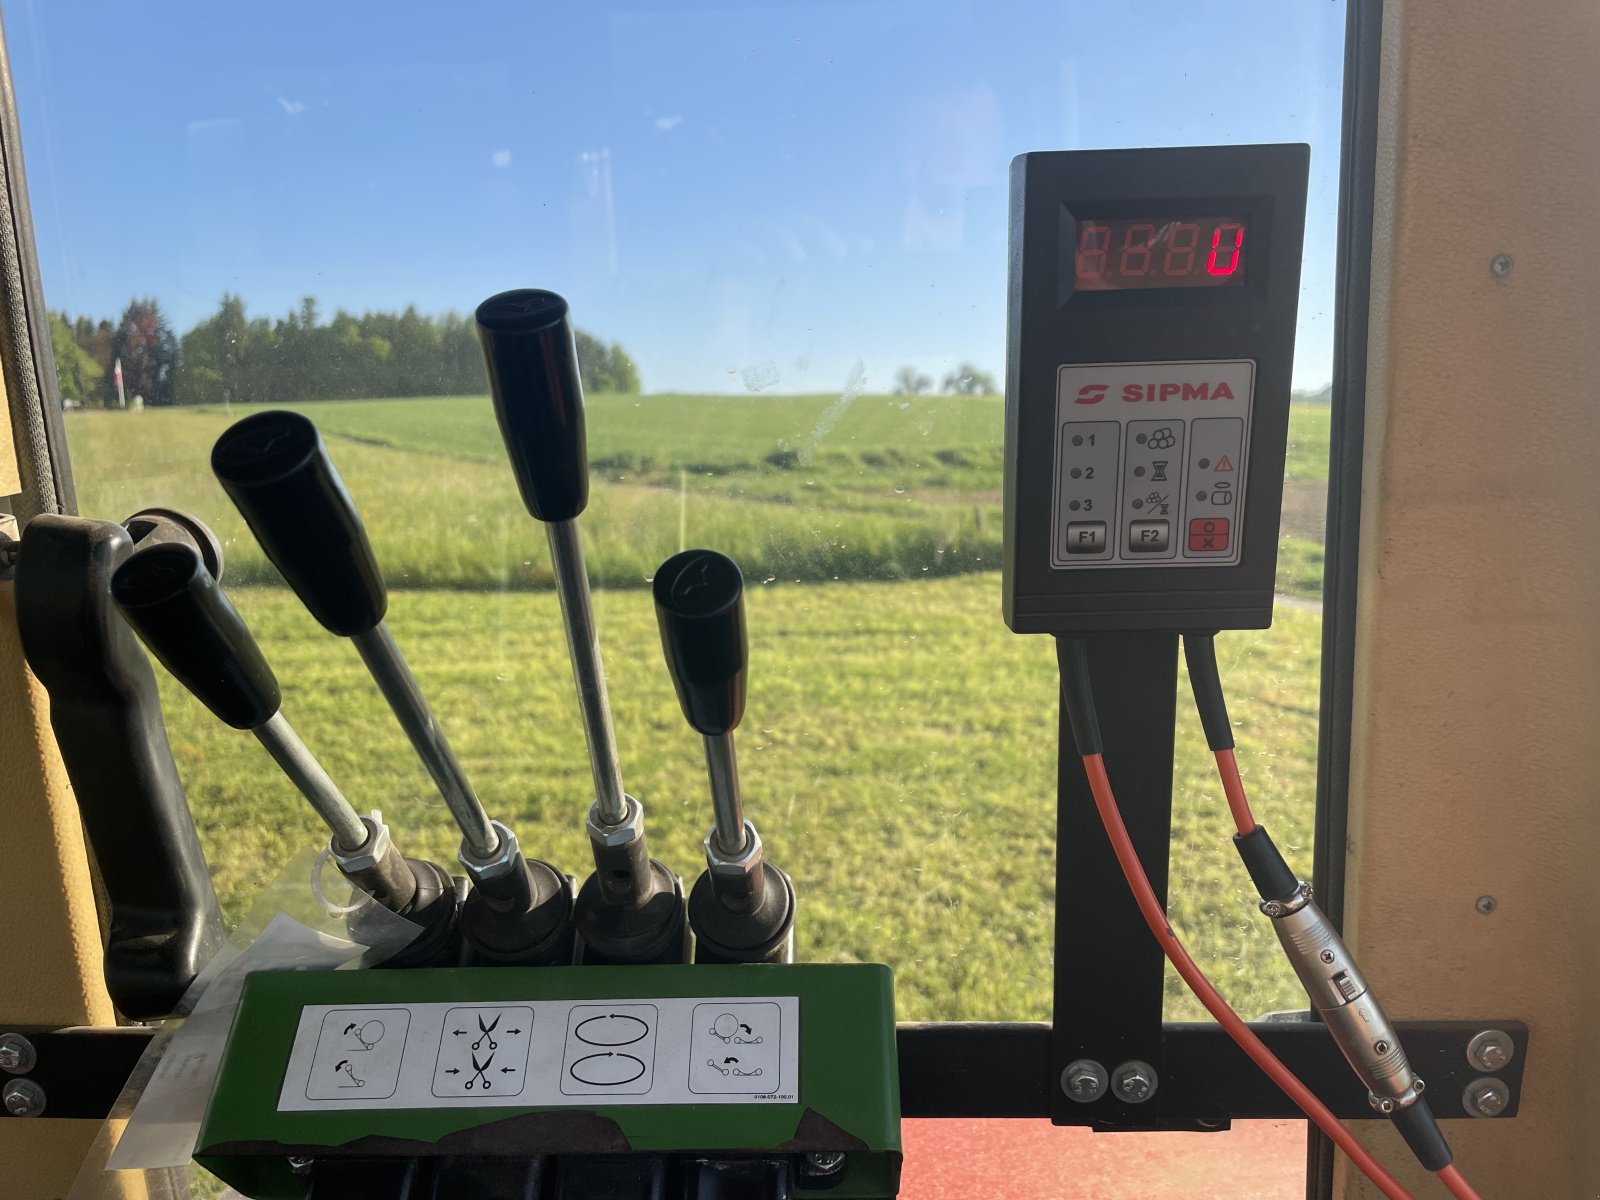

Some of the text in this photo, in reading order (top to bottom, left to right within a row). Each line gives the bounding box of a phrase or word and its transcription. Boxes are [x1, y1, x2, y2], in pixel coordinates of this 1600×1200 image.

[1122, 382, 1235, 403] SIPMA
[1088, 434, 1096, 447] 1
[1085, 467, 1095, 480] 2
[1083, 499, 1093, 512] 3
[1078, 531, 1097, 544] F1
[1140, 530, 1160, 543] F2
